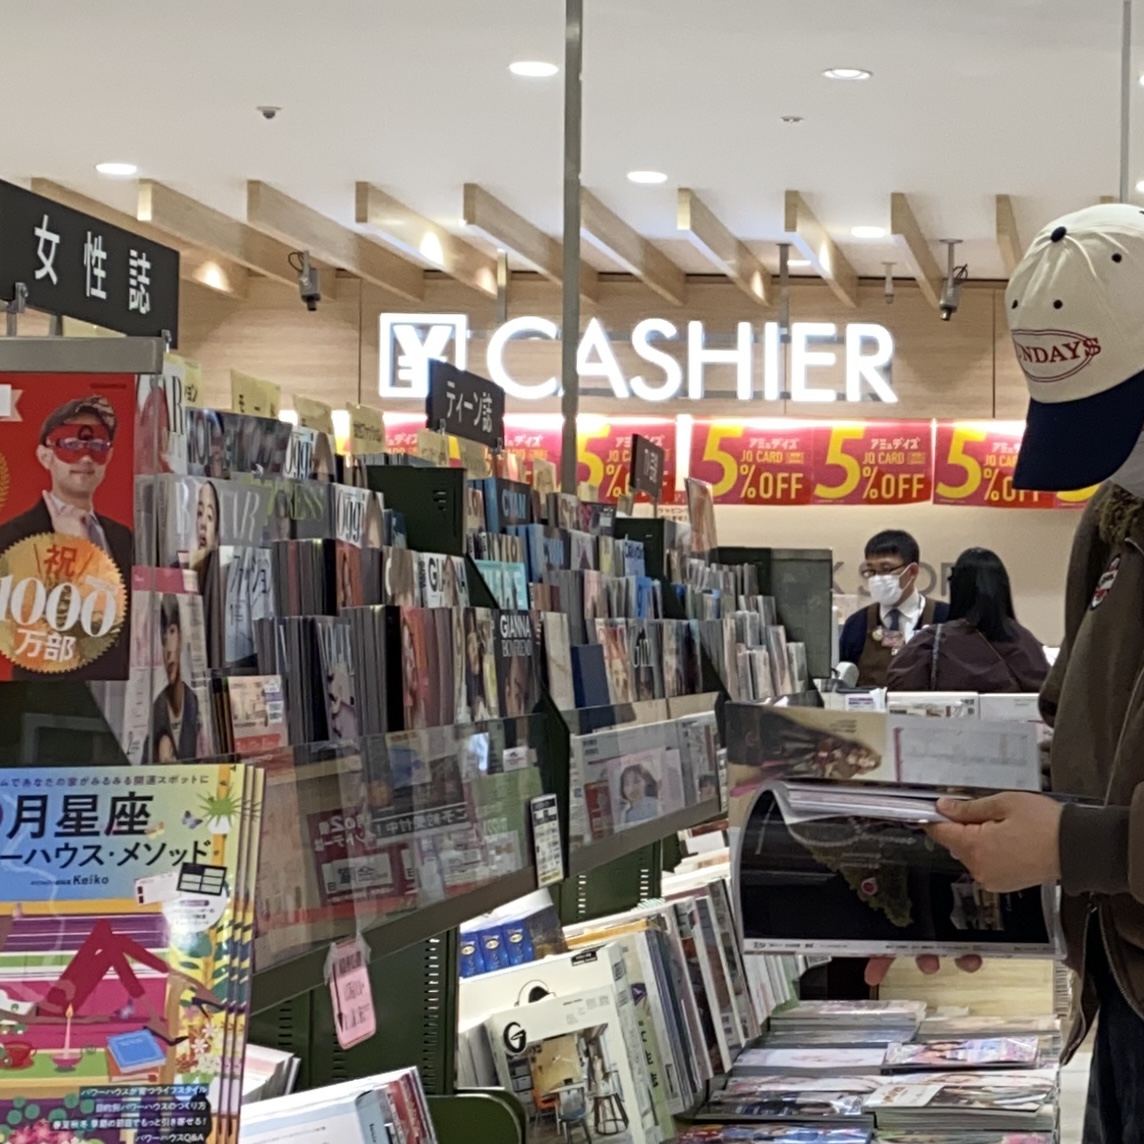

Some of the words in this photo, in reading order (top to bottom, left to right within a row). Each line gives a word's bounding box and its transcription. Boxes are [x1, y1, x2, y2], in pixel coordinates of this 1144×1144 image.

[34, 214, 151, 315] 女性誌
[486, 316, 898, 403] CASHIER
[1019, 336, 1102, 364] NDAYS
[446, 380, 493, 433] ティーン誌
[702, 420, 744, 497] 5
[749, 437, 800, 450] アミュデイズ
[756, 451, 783, 463] CARD
[814, 419, 866, 499] 5
[871, 437, 922, 450] アミュデイズ
[878, 452, 904, 465] CARD
[936, 426, 988, 499] 5
[740, 464, 804, 499] %OFF
[863, 466, 925, 499] %OFF
[44, 544, 78, 578] 祝
[0, 574, 117, 638] 1000
[15, 628, 77, 662] 万部
[72, 874, 110, 886] Keiko
